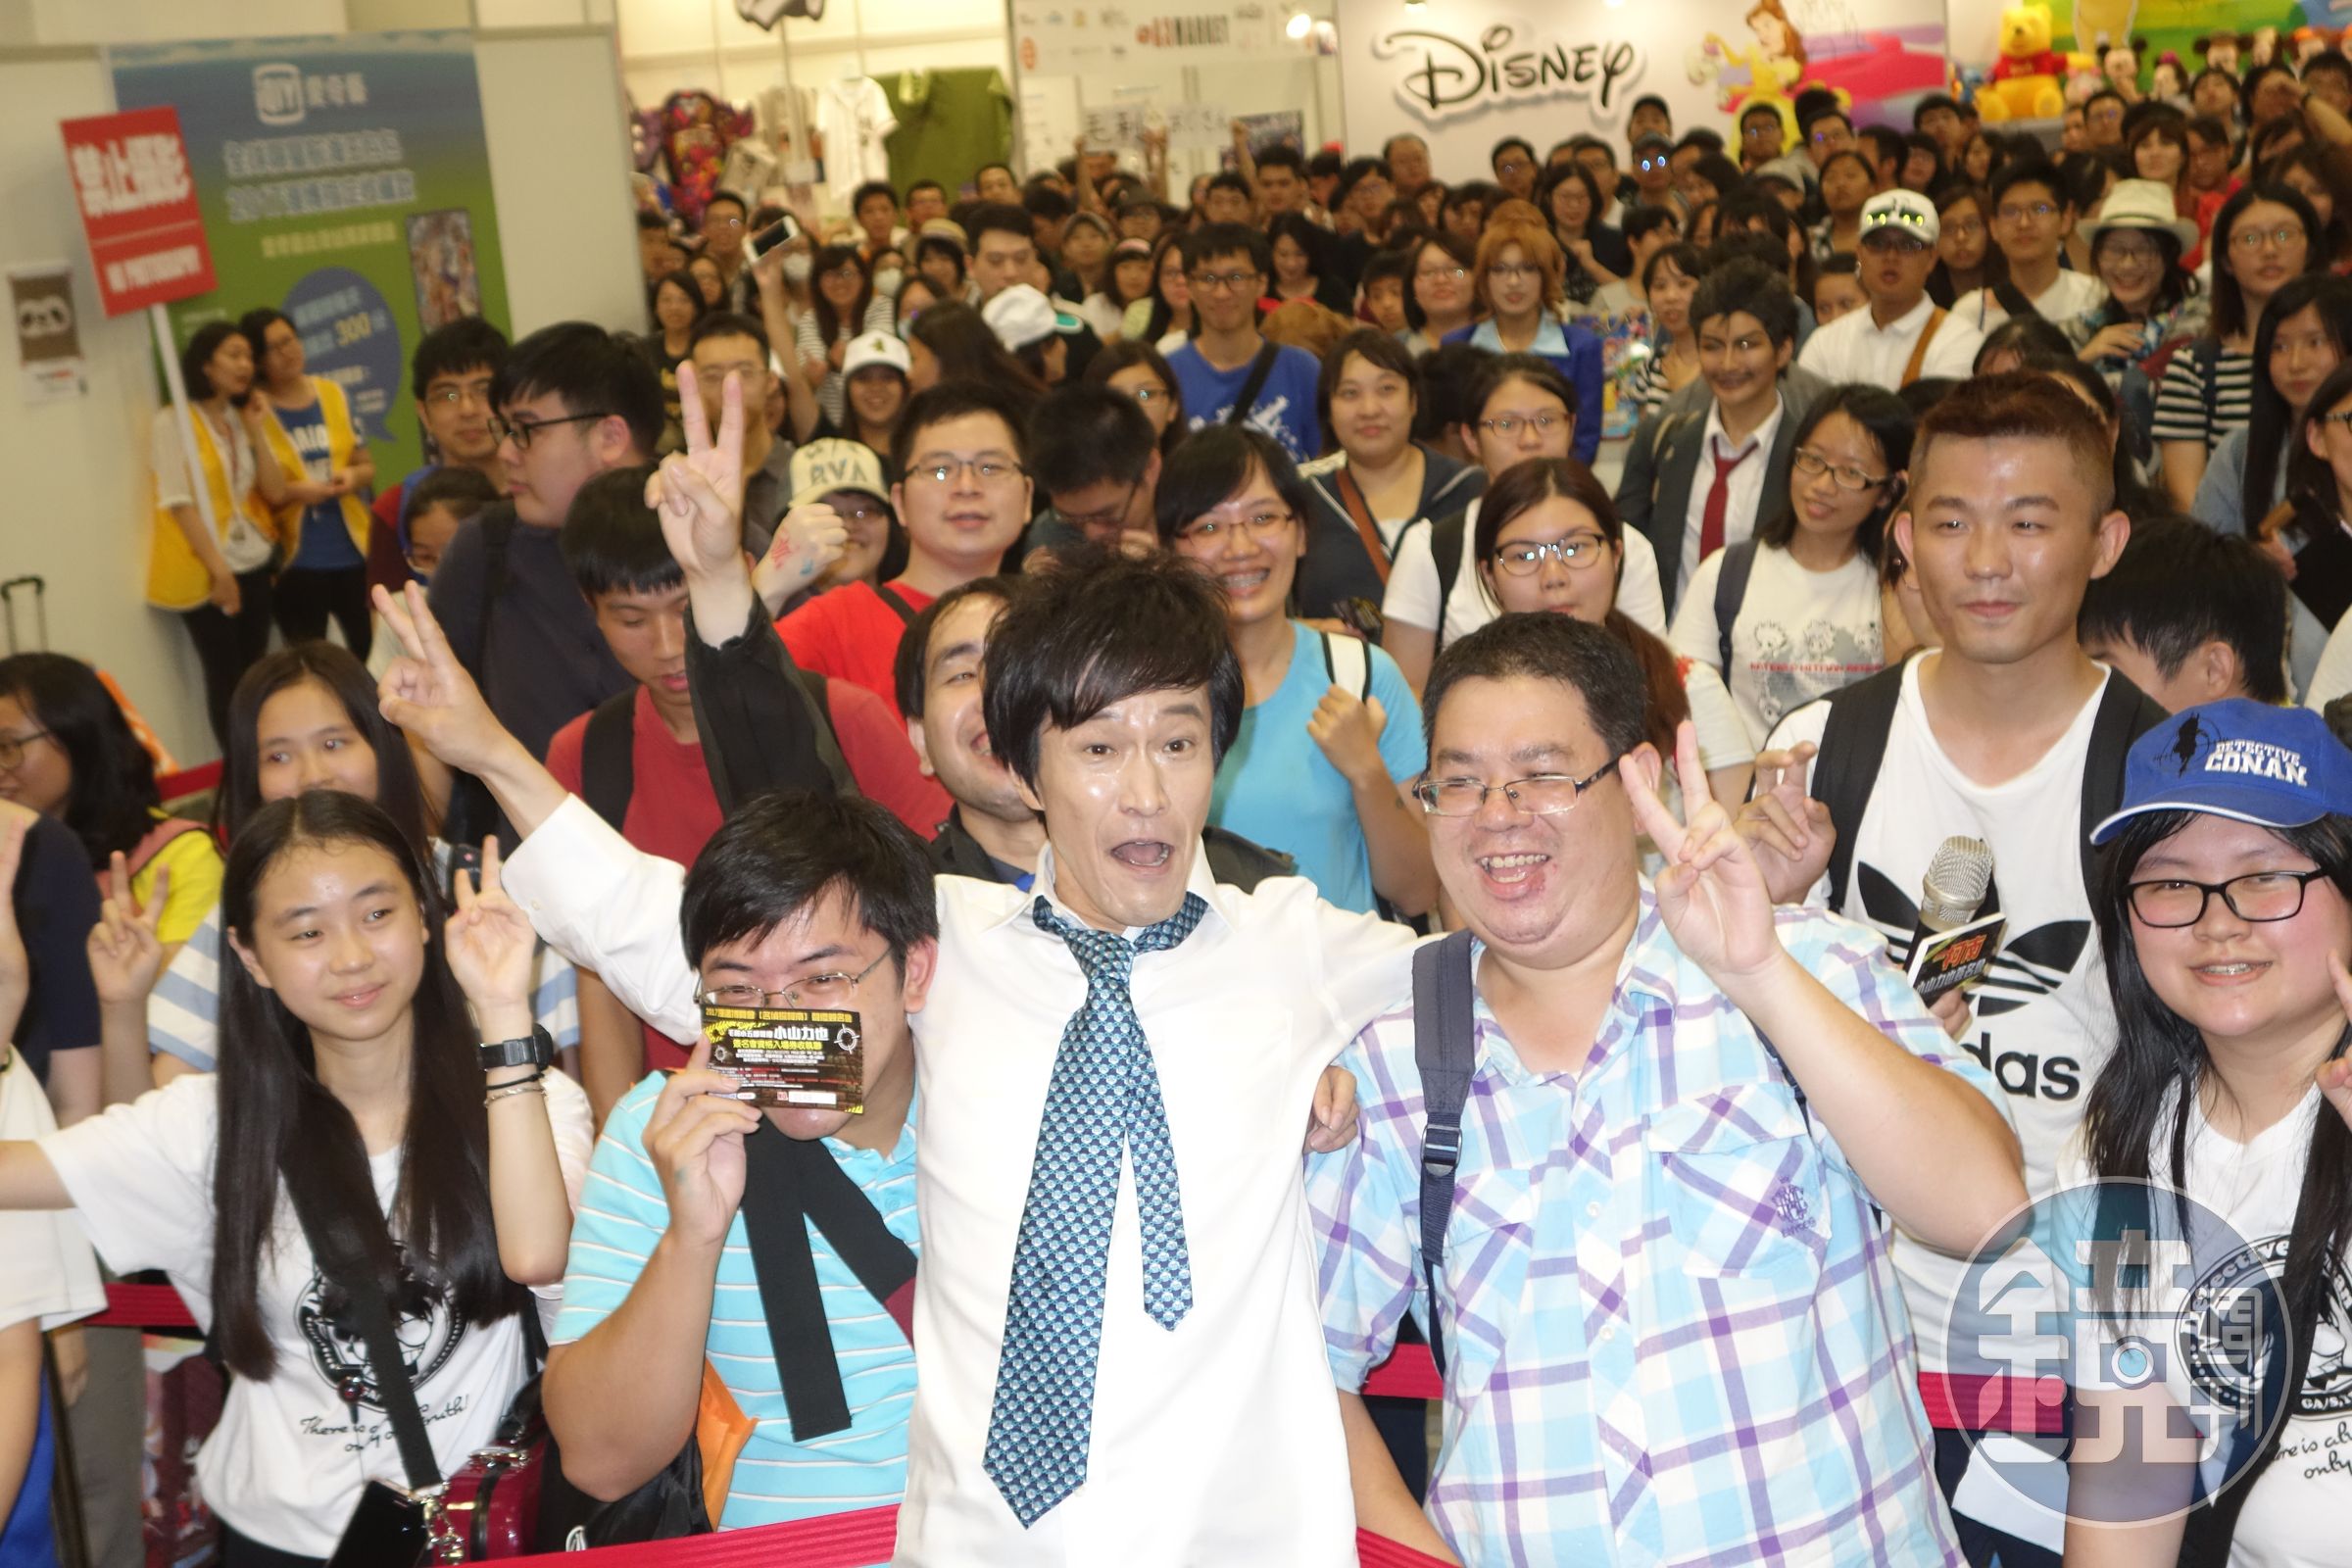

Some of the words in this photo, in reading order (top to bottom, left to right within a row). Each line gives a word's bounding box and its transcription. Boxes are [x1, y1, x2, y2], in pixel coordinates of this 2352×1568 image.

[335, 312, 371, 346] 300
[2215, 739, 2301, 766] DETECTIVE
[2204, 751, 2308, 787] CONAN
[1960, 1031, 2081, 1102] das
[300, 1415, 348, 1435] There
[2301, 1438, 2318, 1453] is
